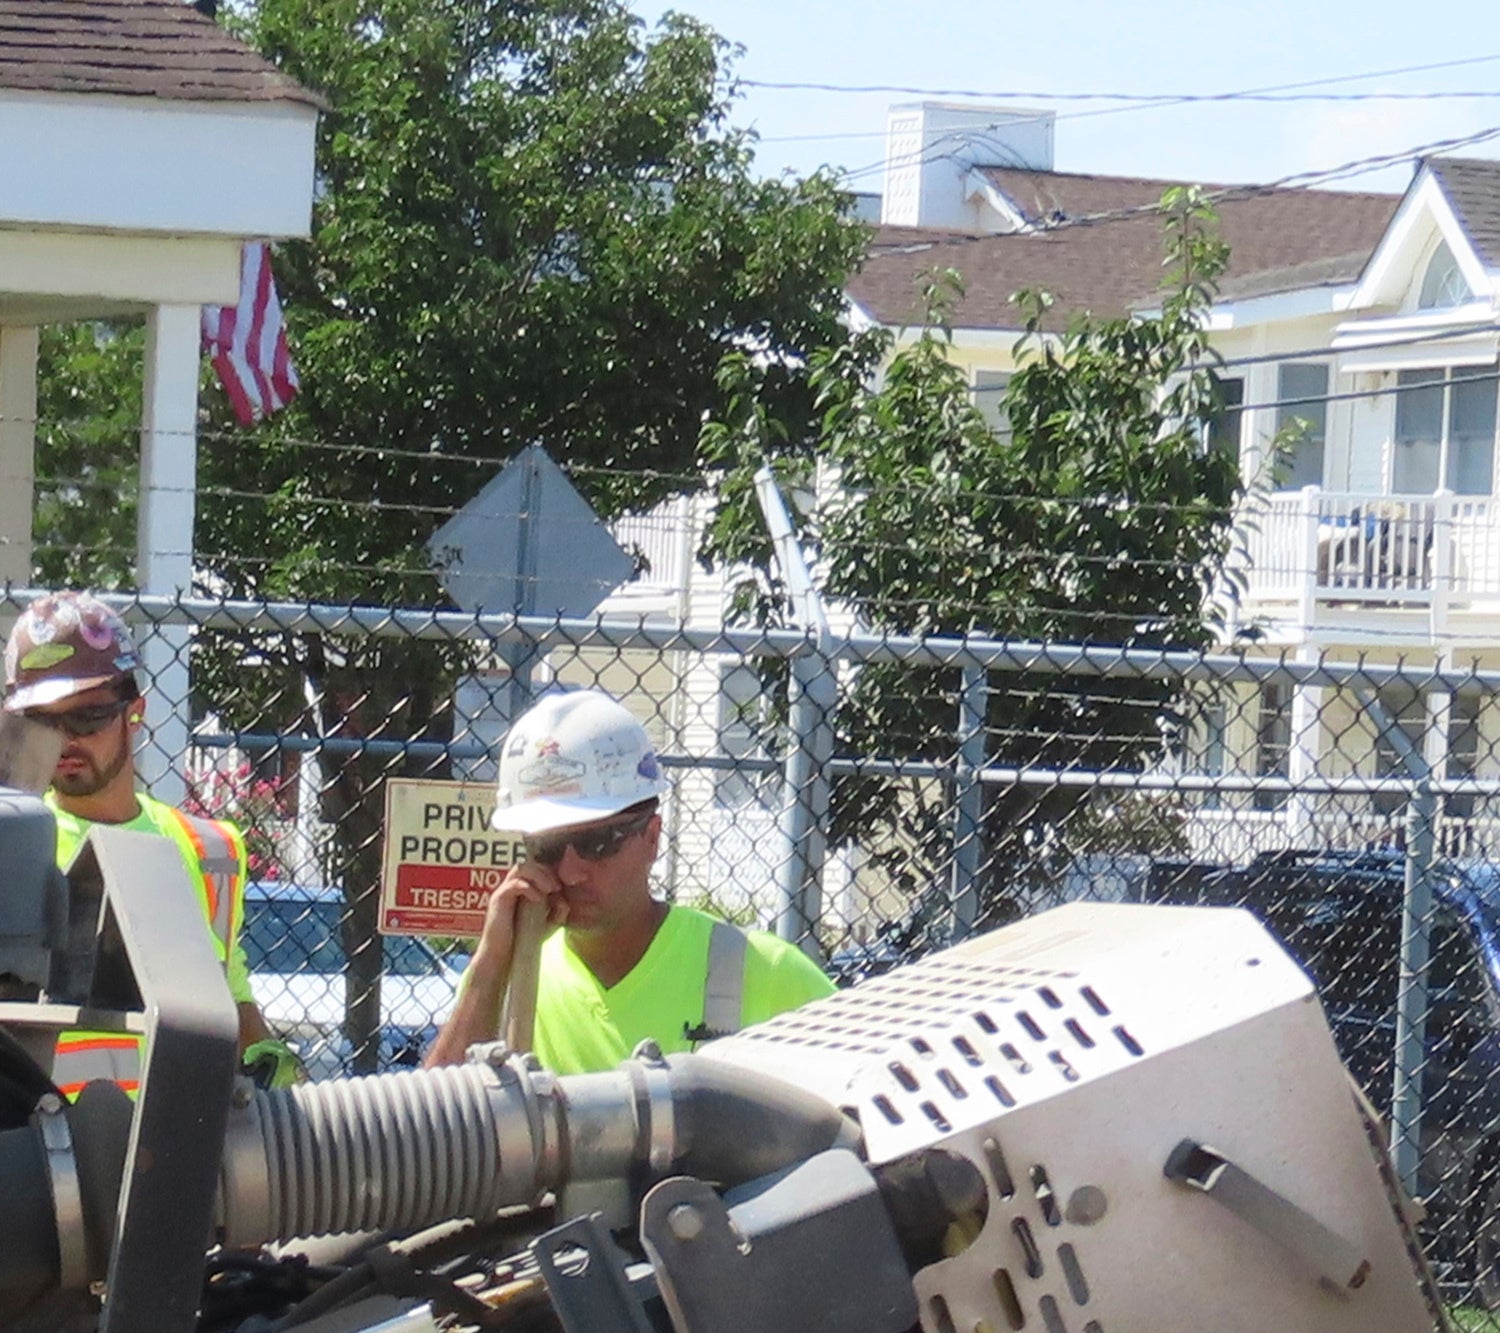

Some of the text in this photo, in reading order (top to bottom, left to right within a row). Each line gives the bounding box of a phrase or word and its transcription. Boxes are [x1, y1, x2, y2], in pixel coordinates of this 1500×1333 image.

[424, 803, 494, 832] PRIV
[401, 836, 528, 865] PROPER
[470, 870, 500, 888] NO
[410, 888, 490, 910] TRESPA
